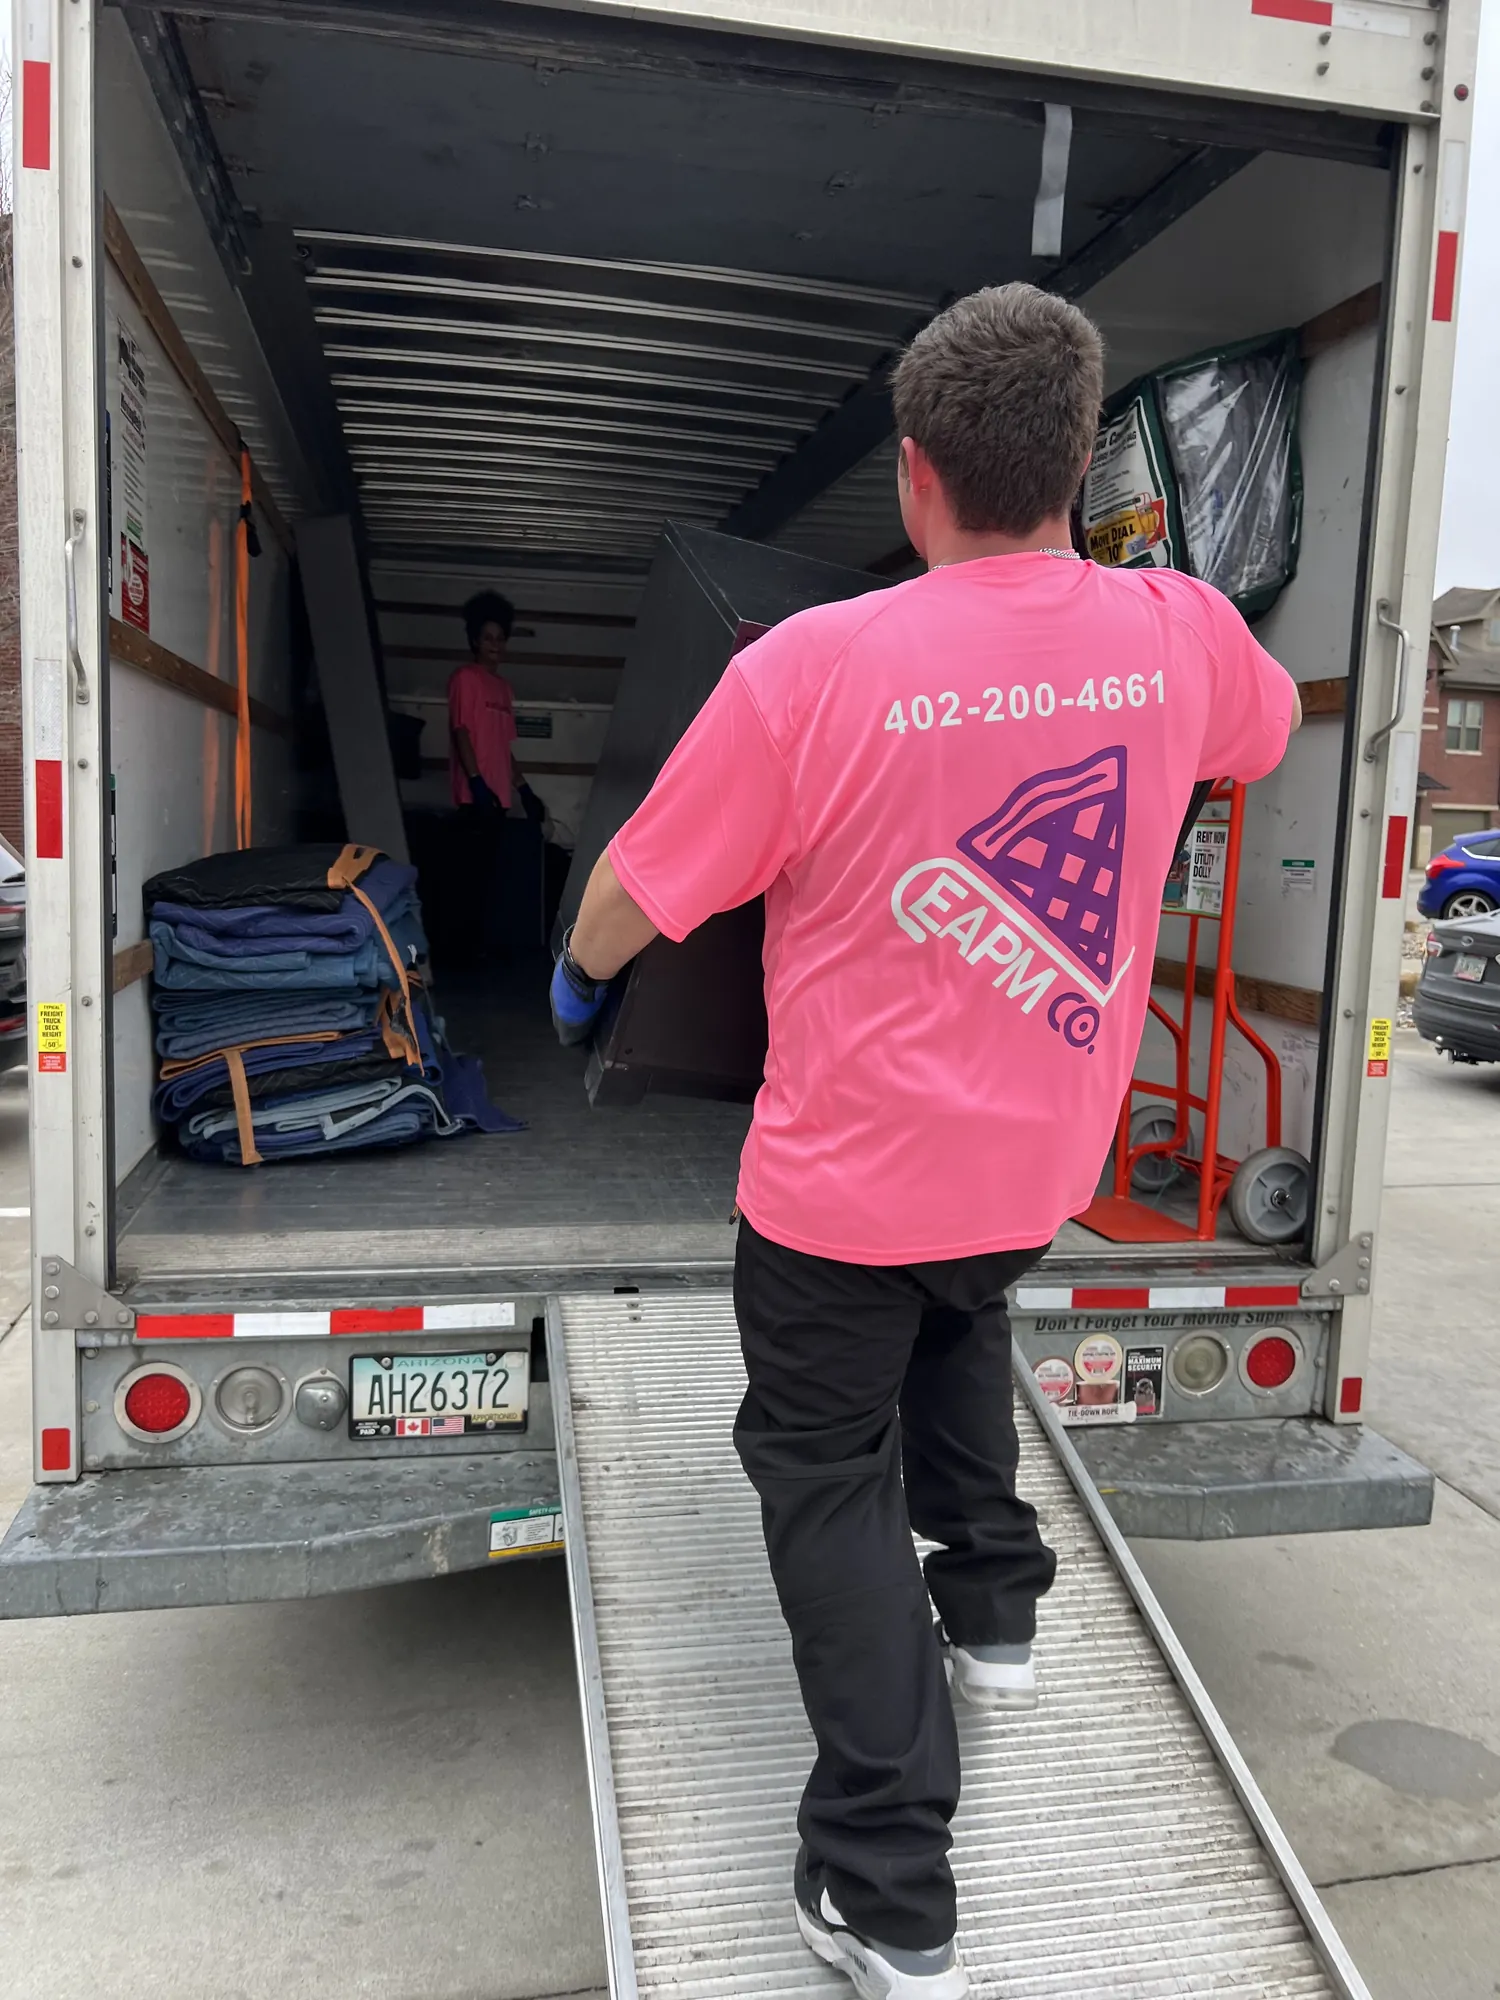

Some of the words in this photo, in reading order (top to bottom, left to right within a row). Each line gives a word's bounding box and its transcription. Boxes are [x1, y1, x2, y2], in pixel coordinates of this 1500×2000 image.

[884, 670, 1166, 735] 402-200-4661
[1196, 831, 1213, 843] RENT
[1213, 832, 1226, 844] NOW
[1194, 853, 1215, 865] UTILITY
[1193, 866, 1211, 878] DOLLY
[1034, 1315, 1079, 1332] Don't
[1085, 1314, 1138, 1332] Forget
[1143, 1314, 1178, 1327] Your
[397, 1356, 484, 1368] ARIZONA
[1128, 1357, 1162, 1365] MAXIMUM
[368, 1368, 510, 1416] AH26372
[472, 1412, 518, 1421] APPORTIONED
[1068, 1409, 1100, 1417] TIE-DOWN
[1101, 1408, 1119, 1416] ROPE
